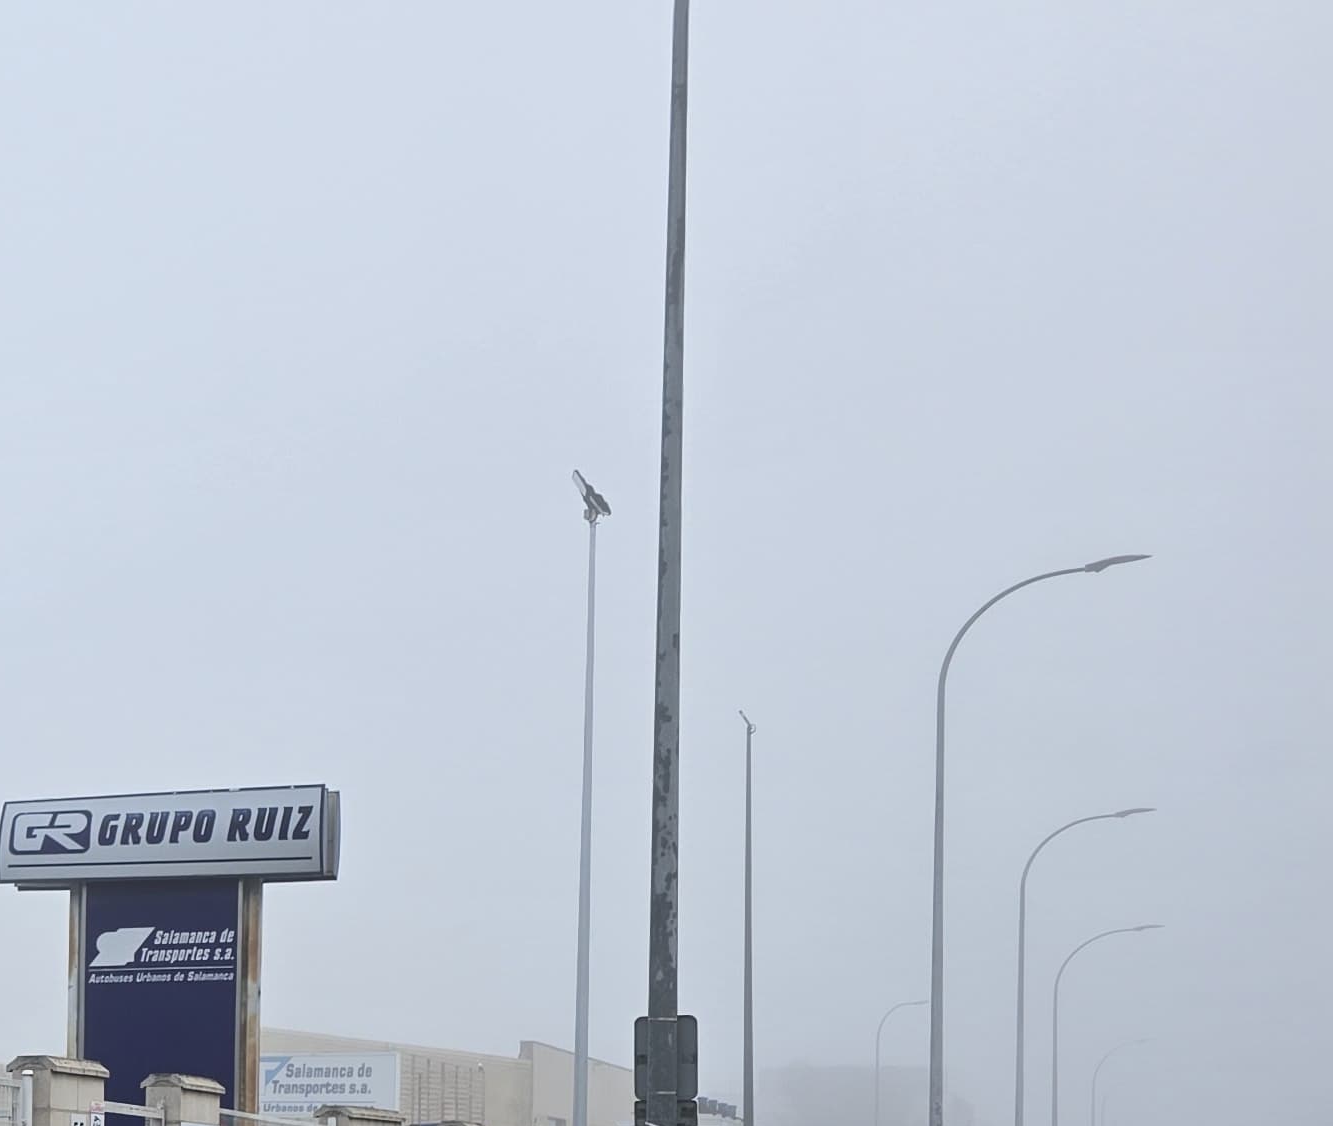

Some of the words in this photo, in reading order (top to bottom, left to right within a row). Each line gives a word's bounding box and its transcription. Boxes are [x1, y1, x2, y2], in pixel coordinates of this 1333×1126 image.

[98, 809, 216, 846] GRUPO
[227, 805, 314, 842] RUIZ
[153, 930, 216, 945] Salamanca
[219, 928, 234, 943] de
[140, 946, 210, 963] Transportes
[213, 947, 235, 961] s.a.
[88, 974, 133, 984] Autobuses
[136, 973, 171, 982] Urbanos
[174, 972, 184, 981] de
[187, 971, 234, 981] Salamanca
[285, 1064, 353, 1079] Salamanca
[357, 1063, 372, 1078] de
[271, 1080, 345, 1098] Transportes
[348, 1083, 372, 1095] s.a.
[263, 1103, 304, 1113] Urbanos
